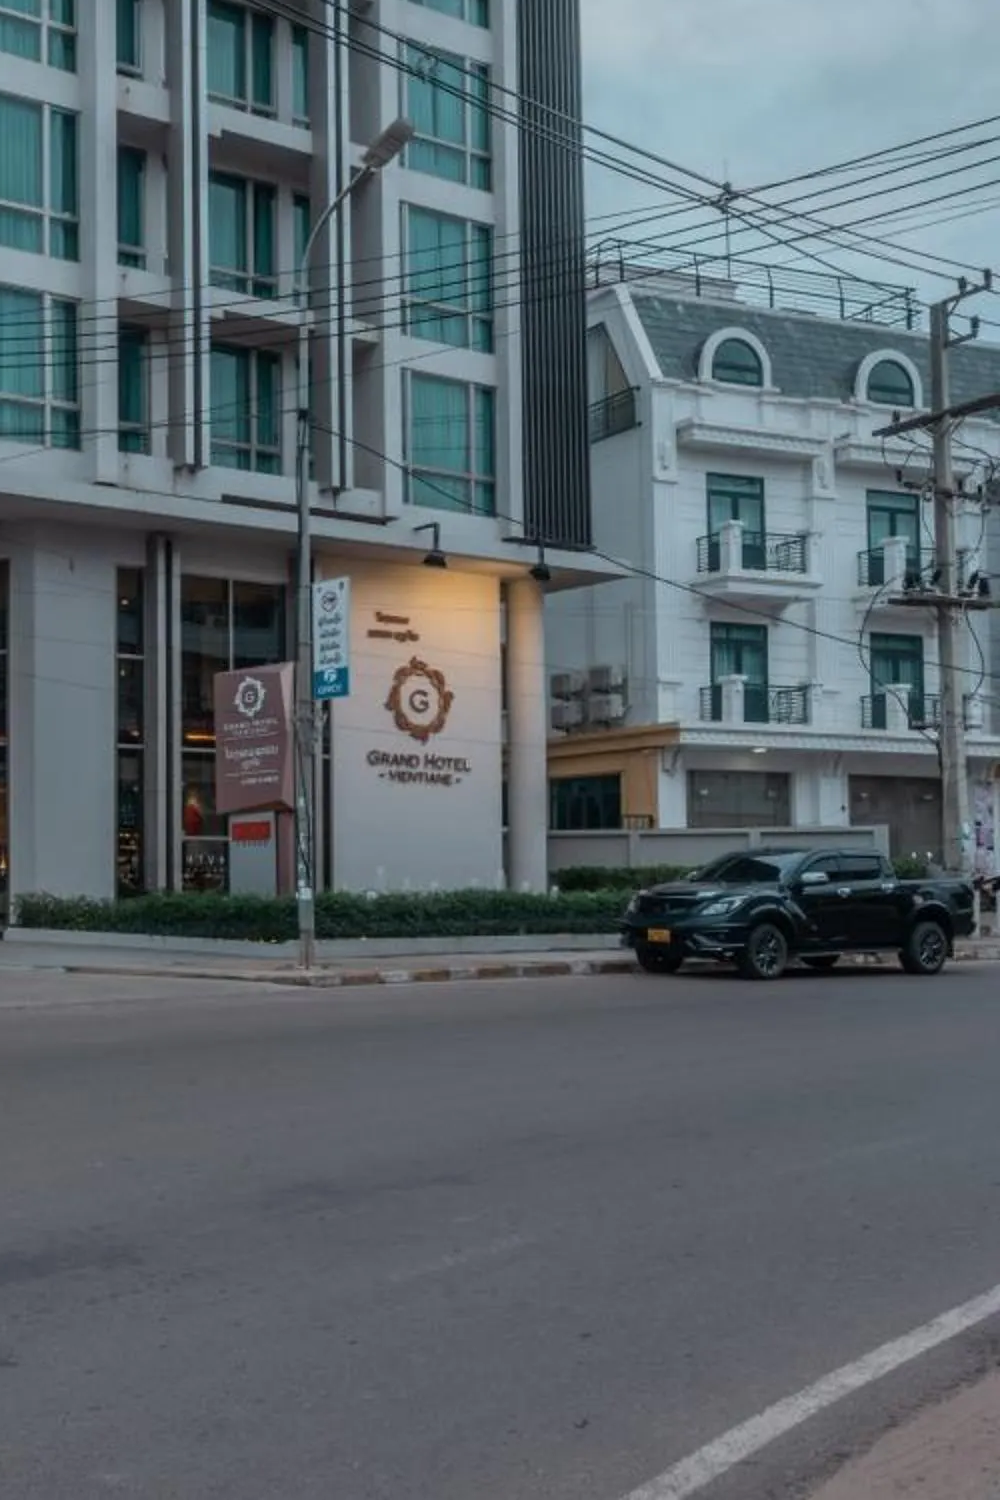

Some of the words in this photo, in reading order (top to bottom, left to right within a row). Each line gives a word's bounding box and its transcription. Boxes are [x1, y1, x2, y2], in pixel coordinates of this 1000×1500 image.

[409, 689, 430, 713] G
[366, 749, 420, 770] GRAND
[423, 752, 472, 773] HOTEL
